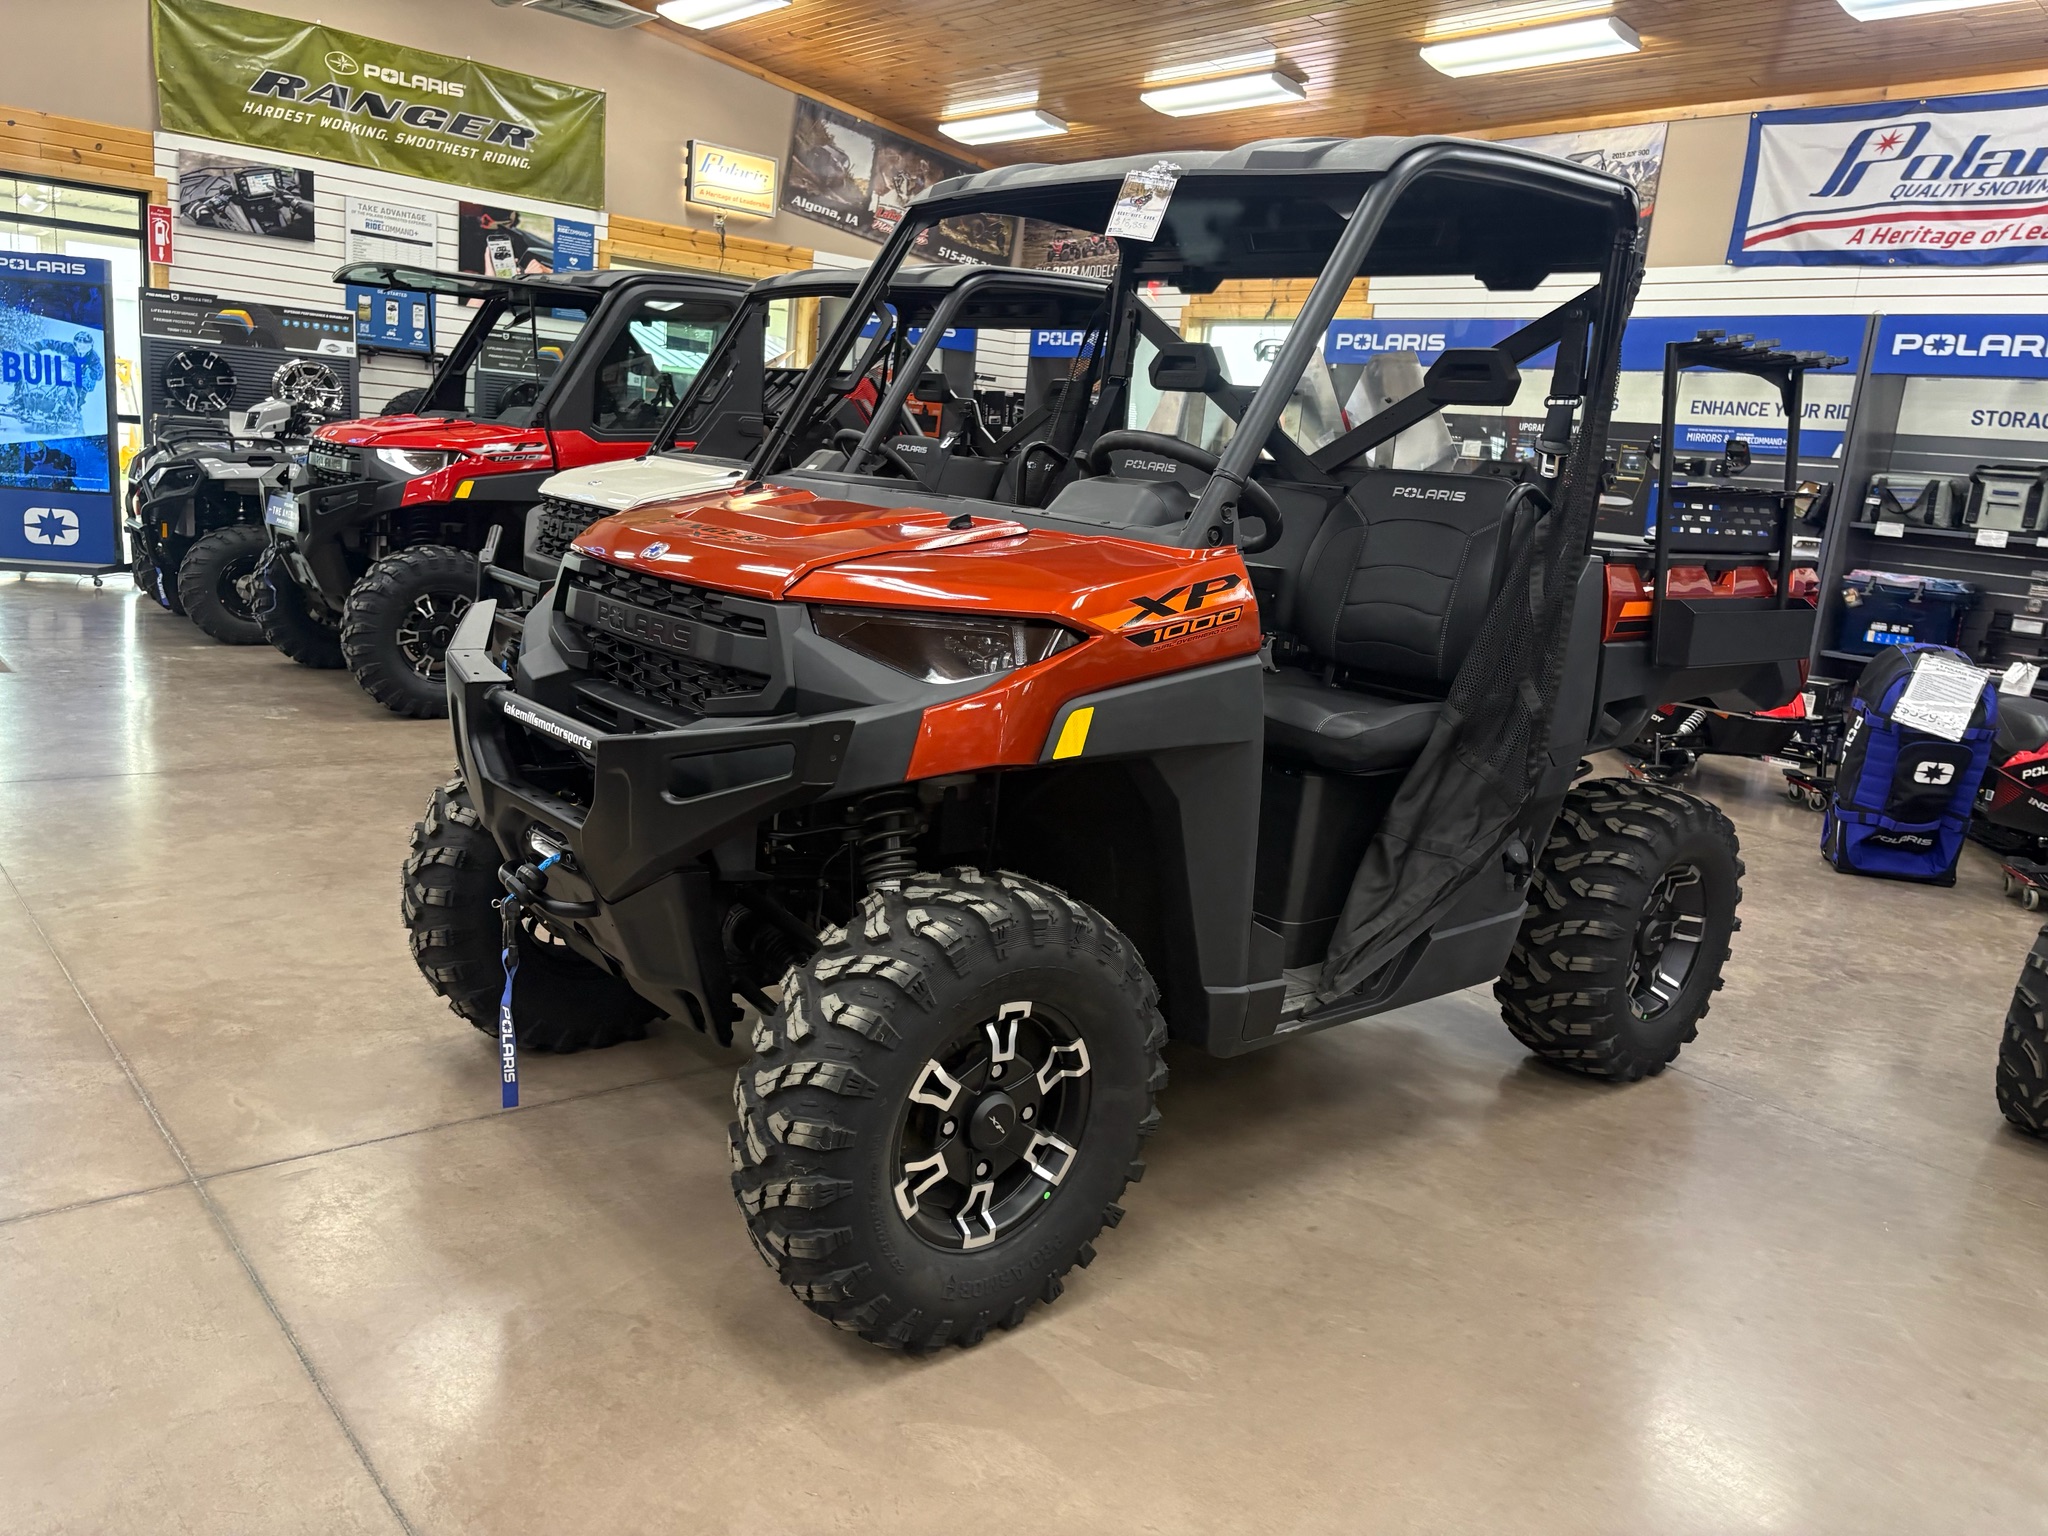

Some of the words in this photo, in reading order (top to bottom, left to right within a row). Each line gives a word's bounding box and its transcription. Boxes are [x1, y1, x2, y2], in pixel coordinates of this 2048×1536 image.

[363, 63, 466, 98] POLARIS
[248, 68, 538, 151] RANGER
[242, 101, 315, 125] HARDEST
[320, 117, 388, 142] WORKING.
[395, 132, 479, 160] SMOOTHEST
[482, 150, 531, 170] RIDING.
[698, 152, 769, 185] Polaris
[1808, 121, 2048, 198] Polar
[1890, 181, 1970, 200] QUALITY
[358, 203, 378, 213] TAKE
[380, 207, 427, 222] ADVANTAGE
[791, 195, 841, 222] Algona,
[845, 212, 859, 227] IA
[1846, 228, 1865, 245] A
[1868, 225, 1976, 249] Heritage
[1980, 223, 2014, 245] of
[1335, 333, 1446, 351] POLARIS
[1891, 333, 2048, 358] POLAR
[2, 350, 88, 388] BUILT
[1690, 400, 1771, 417] ENHANCE
[1775, 403, 1821, 418] YUR
[896, 443, 928, 454] POLARIS
[1686, 432, 1723, 443] MIRRORS
[494, 454, 543, 462] 1000
[1124, 458, 1177, 473] POLARIS
[1392, 486, 1467, 503] POLARIS
[1118, 573, 1244, 630] XP
[597, 601, 691, 651] POLARIS
[1153, 606, 1242, 643] 1000
[1151, 640, 1175, 653] DUAL
[1177, 629, 1220, 646] OVERHEAD
[503, 701, 593, 750] lakemillsmotorsports
[1840, 715, 1864, 771] POLA
[1871, 834, 1934, 847] POLARIS
[502, 1006, 516, 1083] POLARIS
[988, 1115, 1006, 1135] XP
